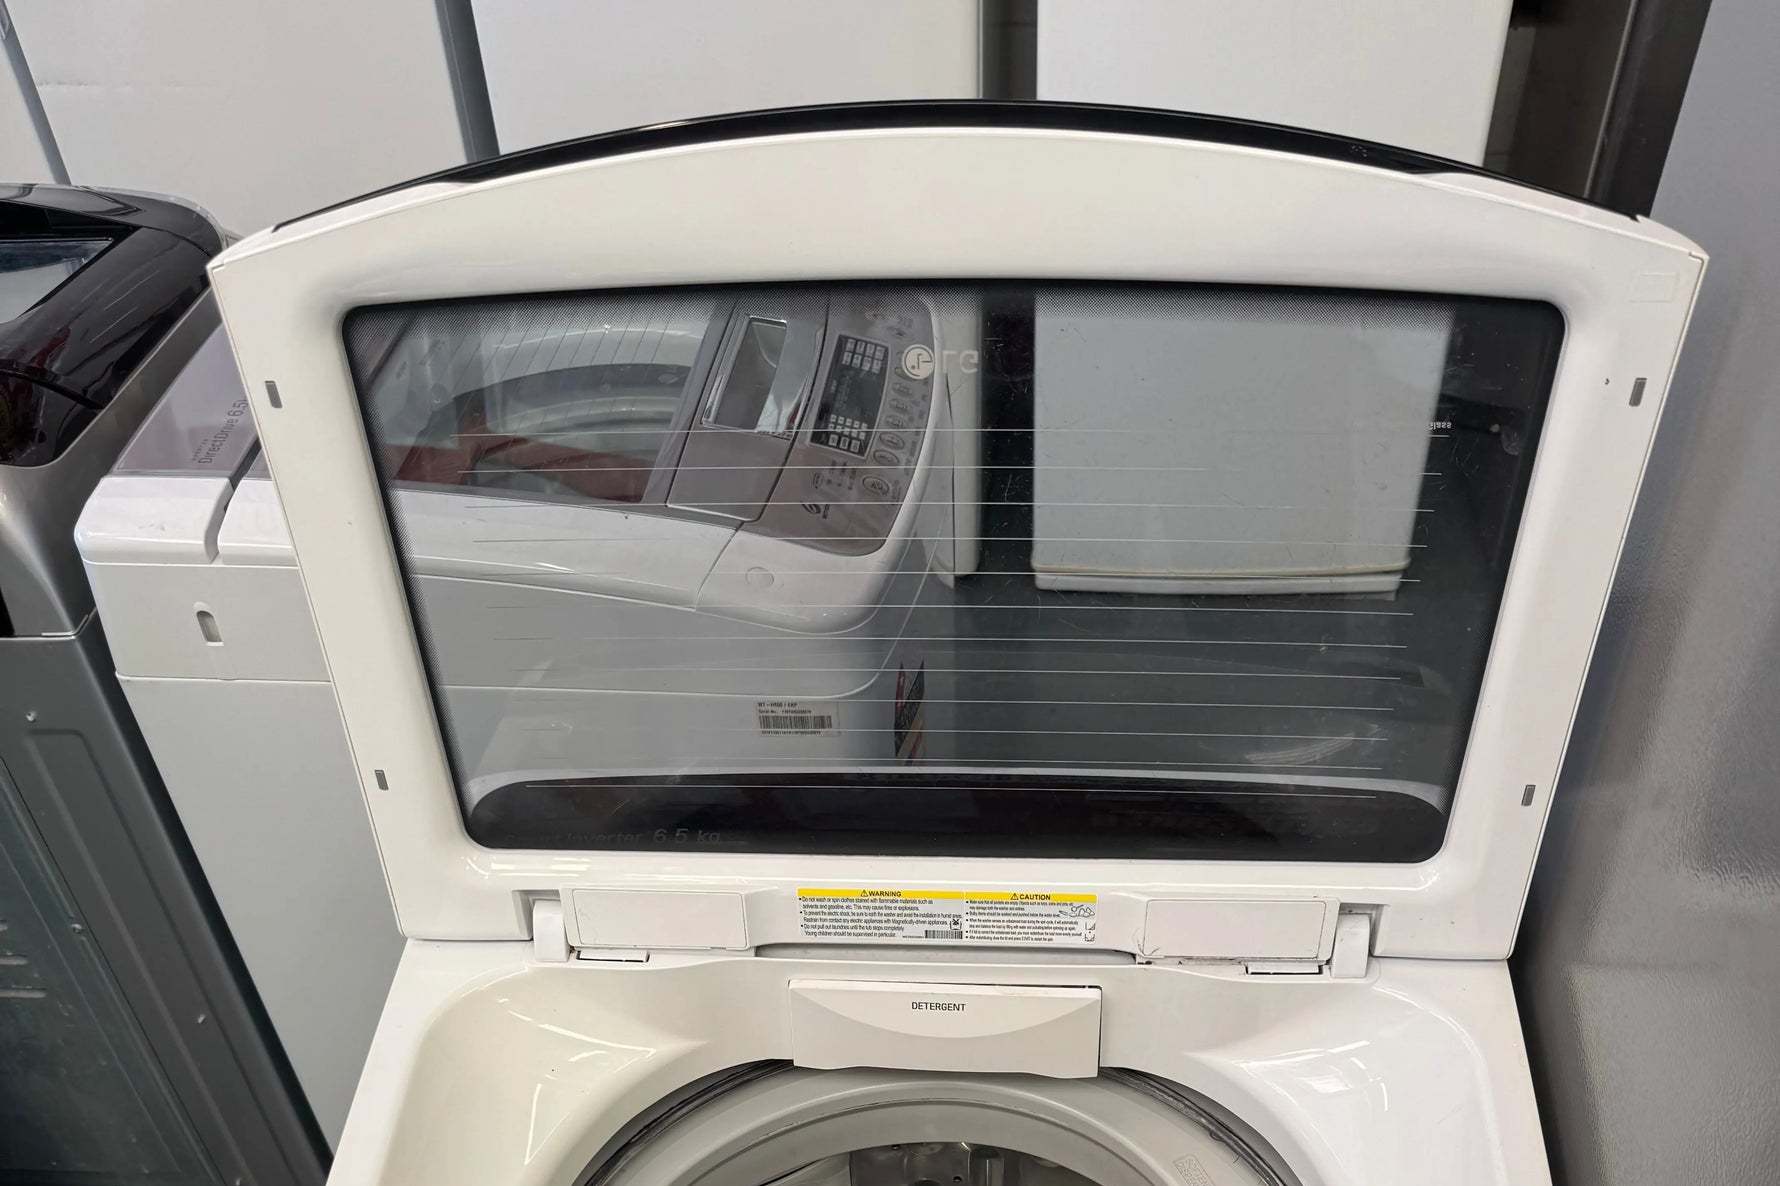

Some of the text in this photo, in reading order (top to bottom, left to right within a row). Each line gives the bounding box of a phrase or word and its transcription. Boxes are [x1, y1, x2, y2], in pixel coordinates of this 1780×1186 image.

[198, 418, 238, 464] DirectDrive
[1019, 893, 1051, 901] CAUTION
[911, 1001, 966, 1012] DETERGENT
